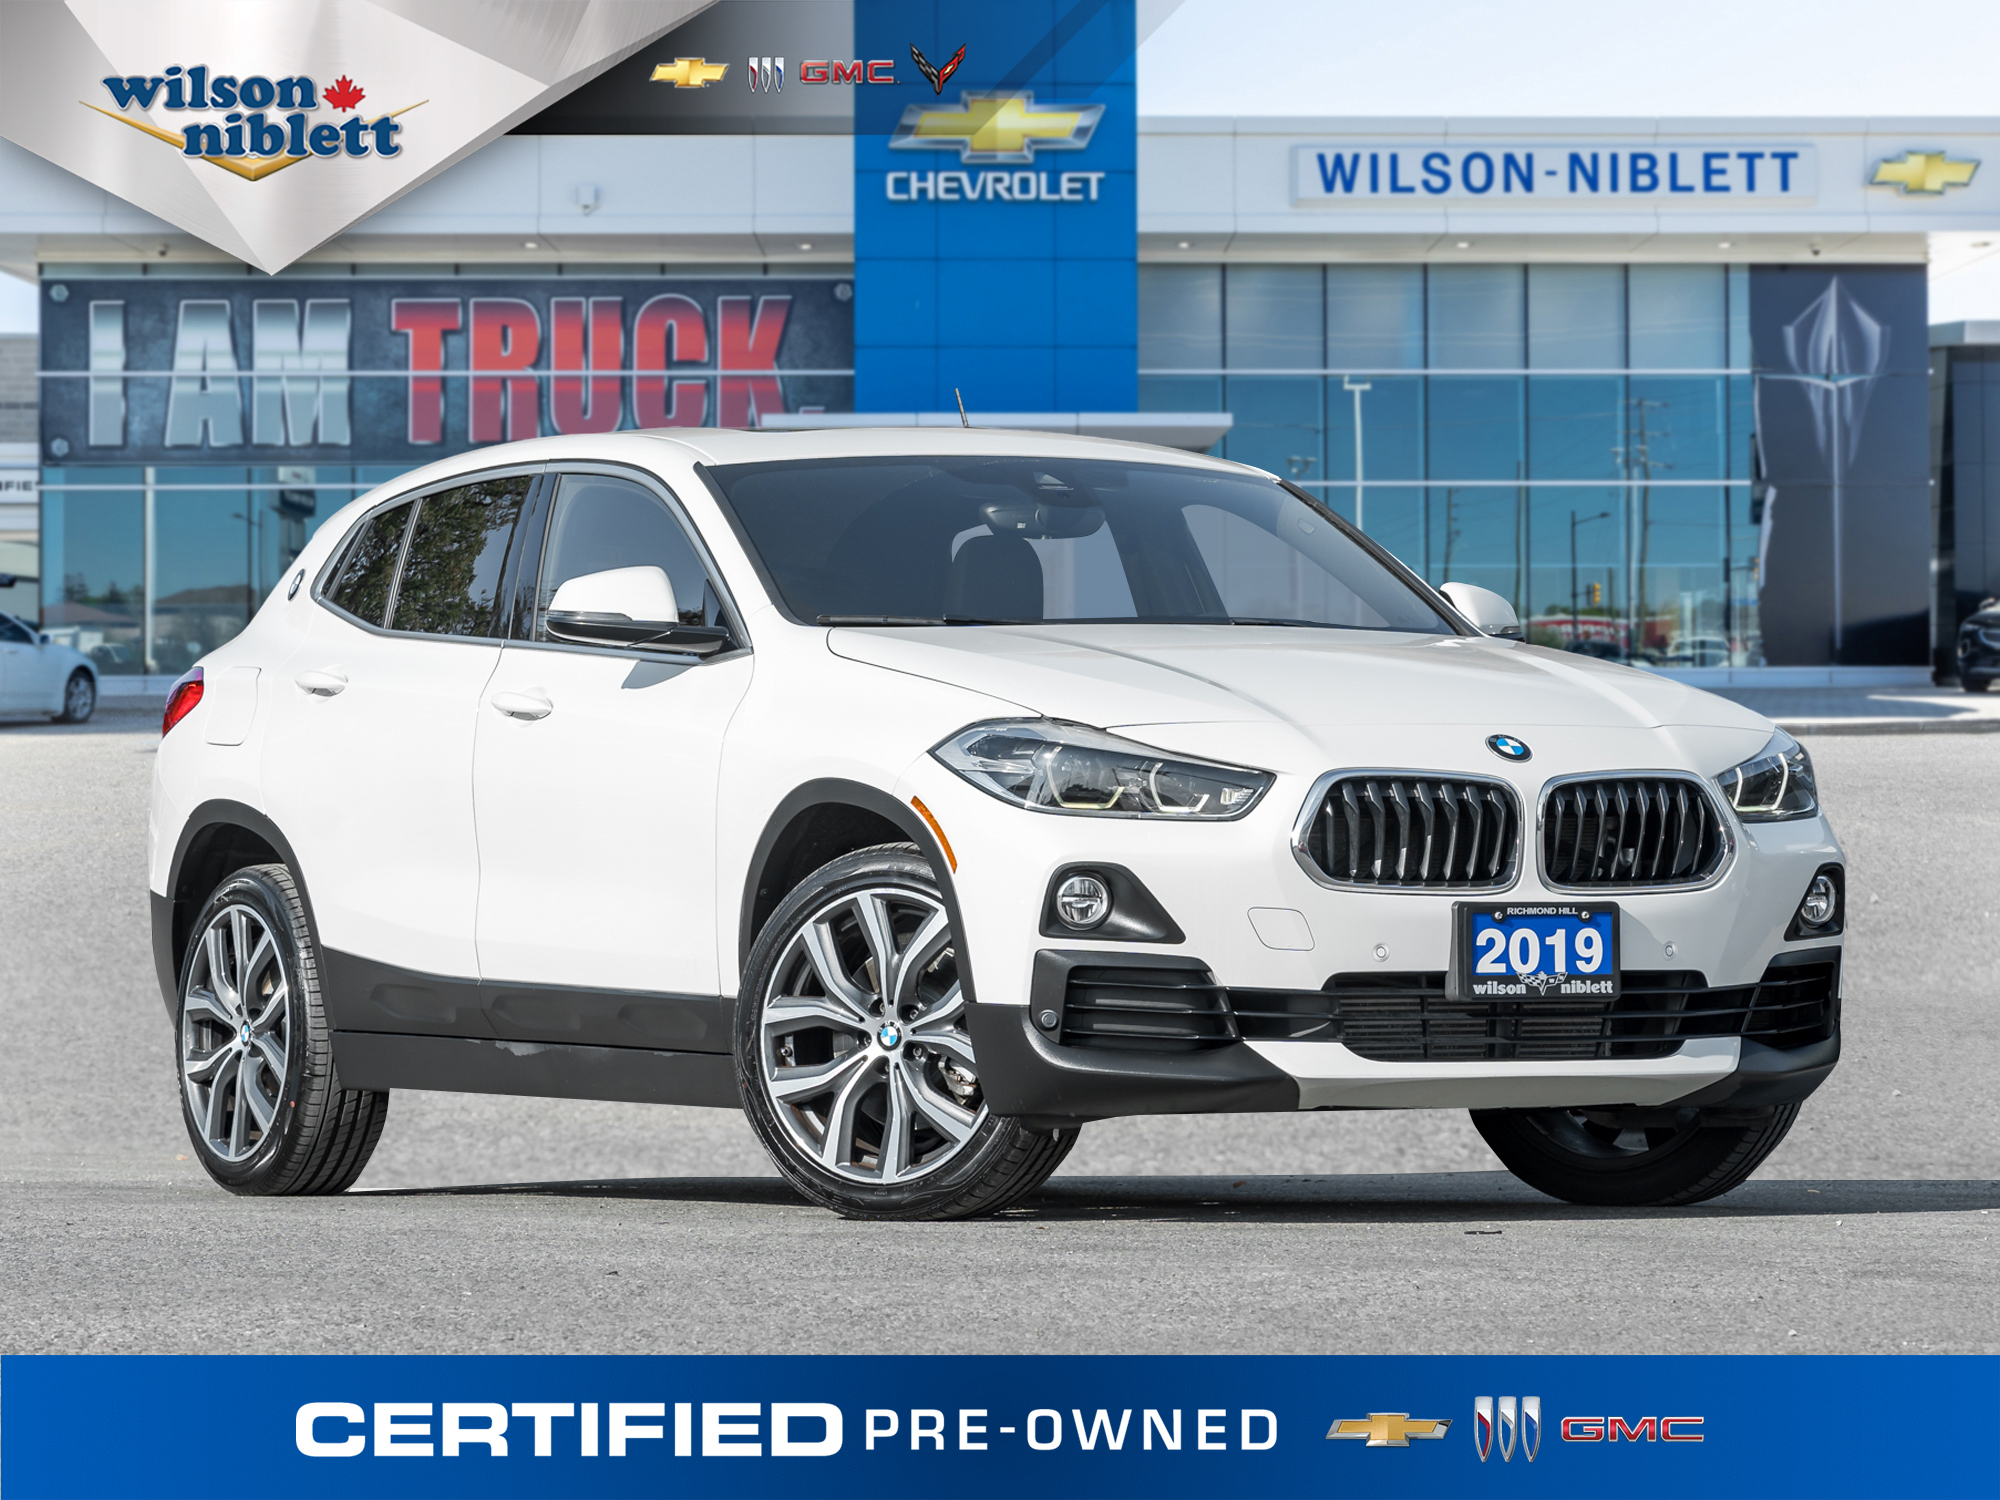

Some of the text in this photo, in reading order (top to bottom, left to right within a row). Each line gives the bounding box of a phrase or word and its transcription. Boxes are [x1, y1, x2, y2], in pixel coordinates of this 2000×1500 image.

[886, 171, 1105, 200] CHEVROLET
[1316, 151, 1799, 194] WILSON-NIBLETT
[89, 299, 126, 447] I
[164, 299, 350, 447] AM
[1507, 907, 1578, 915] RICHMOND HILL
[1476, 928, 1603, 973] 2019
[1473, 980, 1613, 994] wilson niblett
